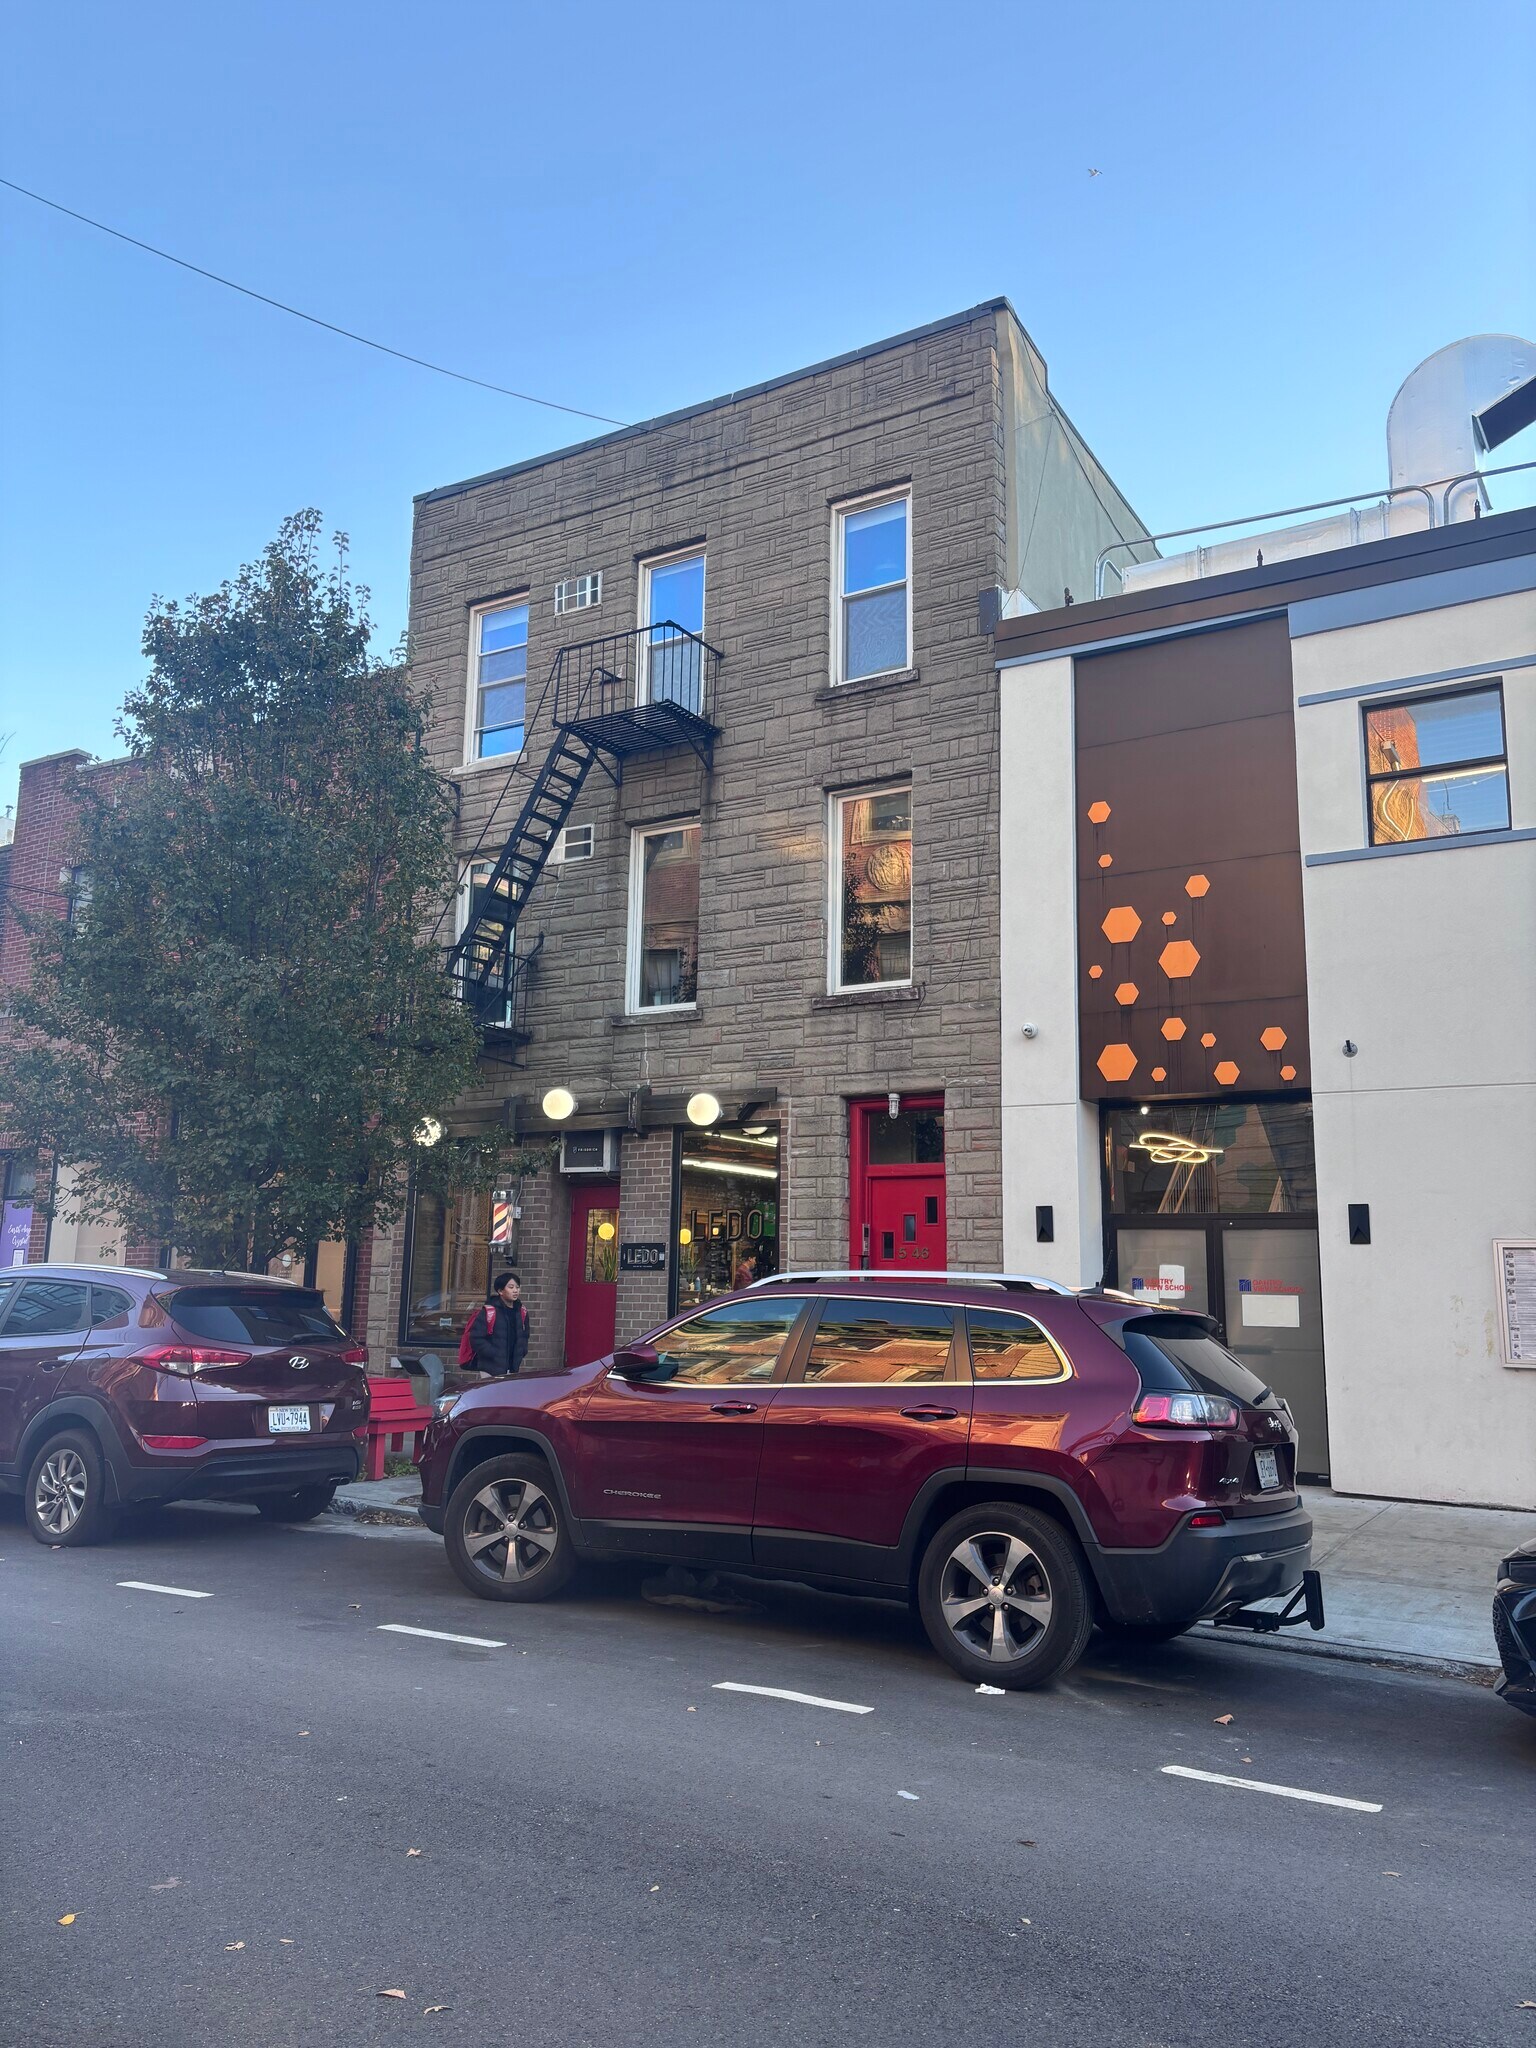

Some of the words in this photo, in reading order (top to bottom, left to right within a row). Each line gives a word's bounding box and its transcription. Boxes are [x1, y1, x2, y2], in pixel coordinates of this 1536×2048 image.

[691, 1209, 763, 1241] LEDO
[627, 1248, 659, 1265] LEDO
[603, 1488, 662, 1500] CHEROKEE
